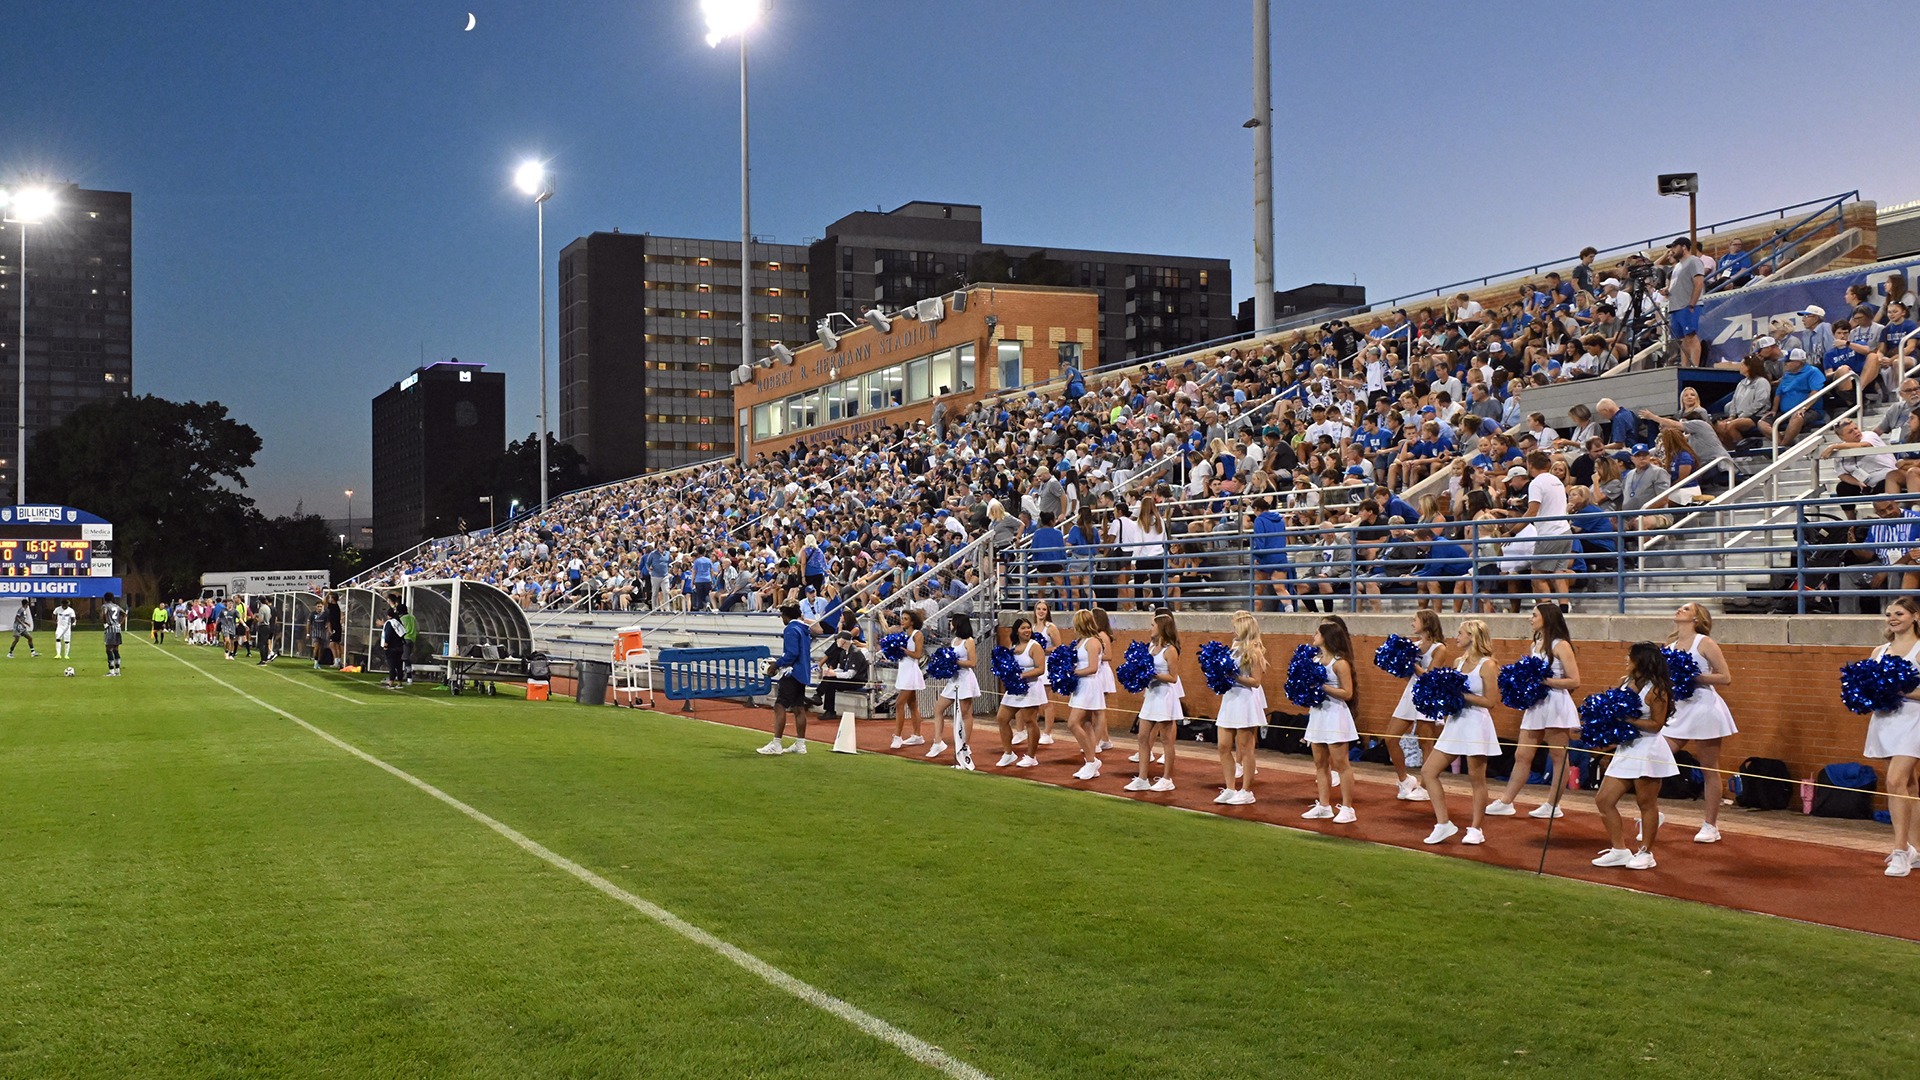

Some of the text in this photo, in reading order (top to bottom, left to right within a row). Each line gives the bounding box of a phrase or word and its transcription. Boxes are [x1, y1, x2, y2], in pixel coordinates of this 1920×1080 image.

[757, 368, 793, 393] ROBERT
[815, 344, 871, 376] HERMANN
[880, 322, 938, 354] STADIUM
[850, 421, 871, 434] PRESS
[19, 508, 60, 518] BILLIKENS
[26, 540, 57, 552] 16:02
[4, 549, 12, 560] 0
[75, 549, 83, 561] 0
[8, 567, 15, 576] 0
[24, 567, 30, 576] 3
[0, 582, 77, 593] BUD LIGHT
[111, 607, 118, 620] 2
